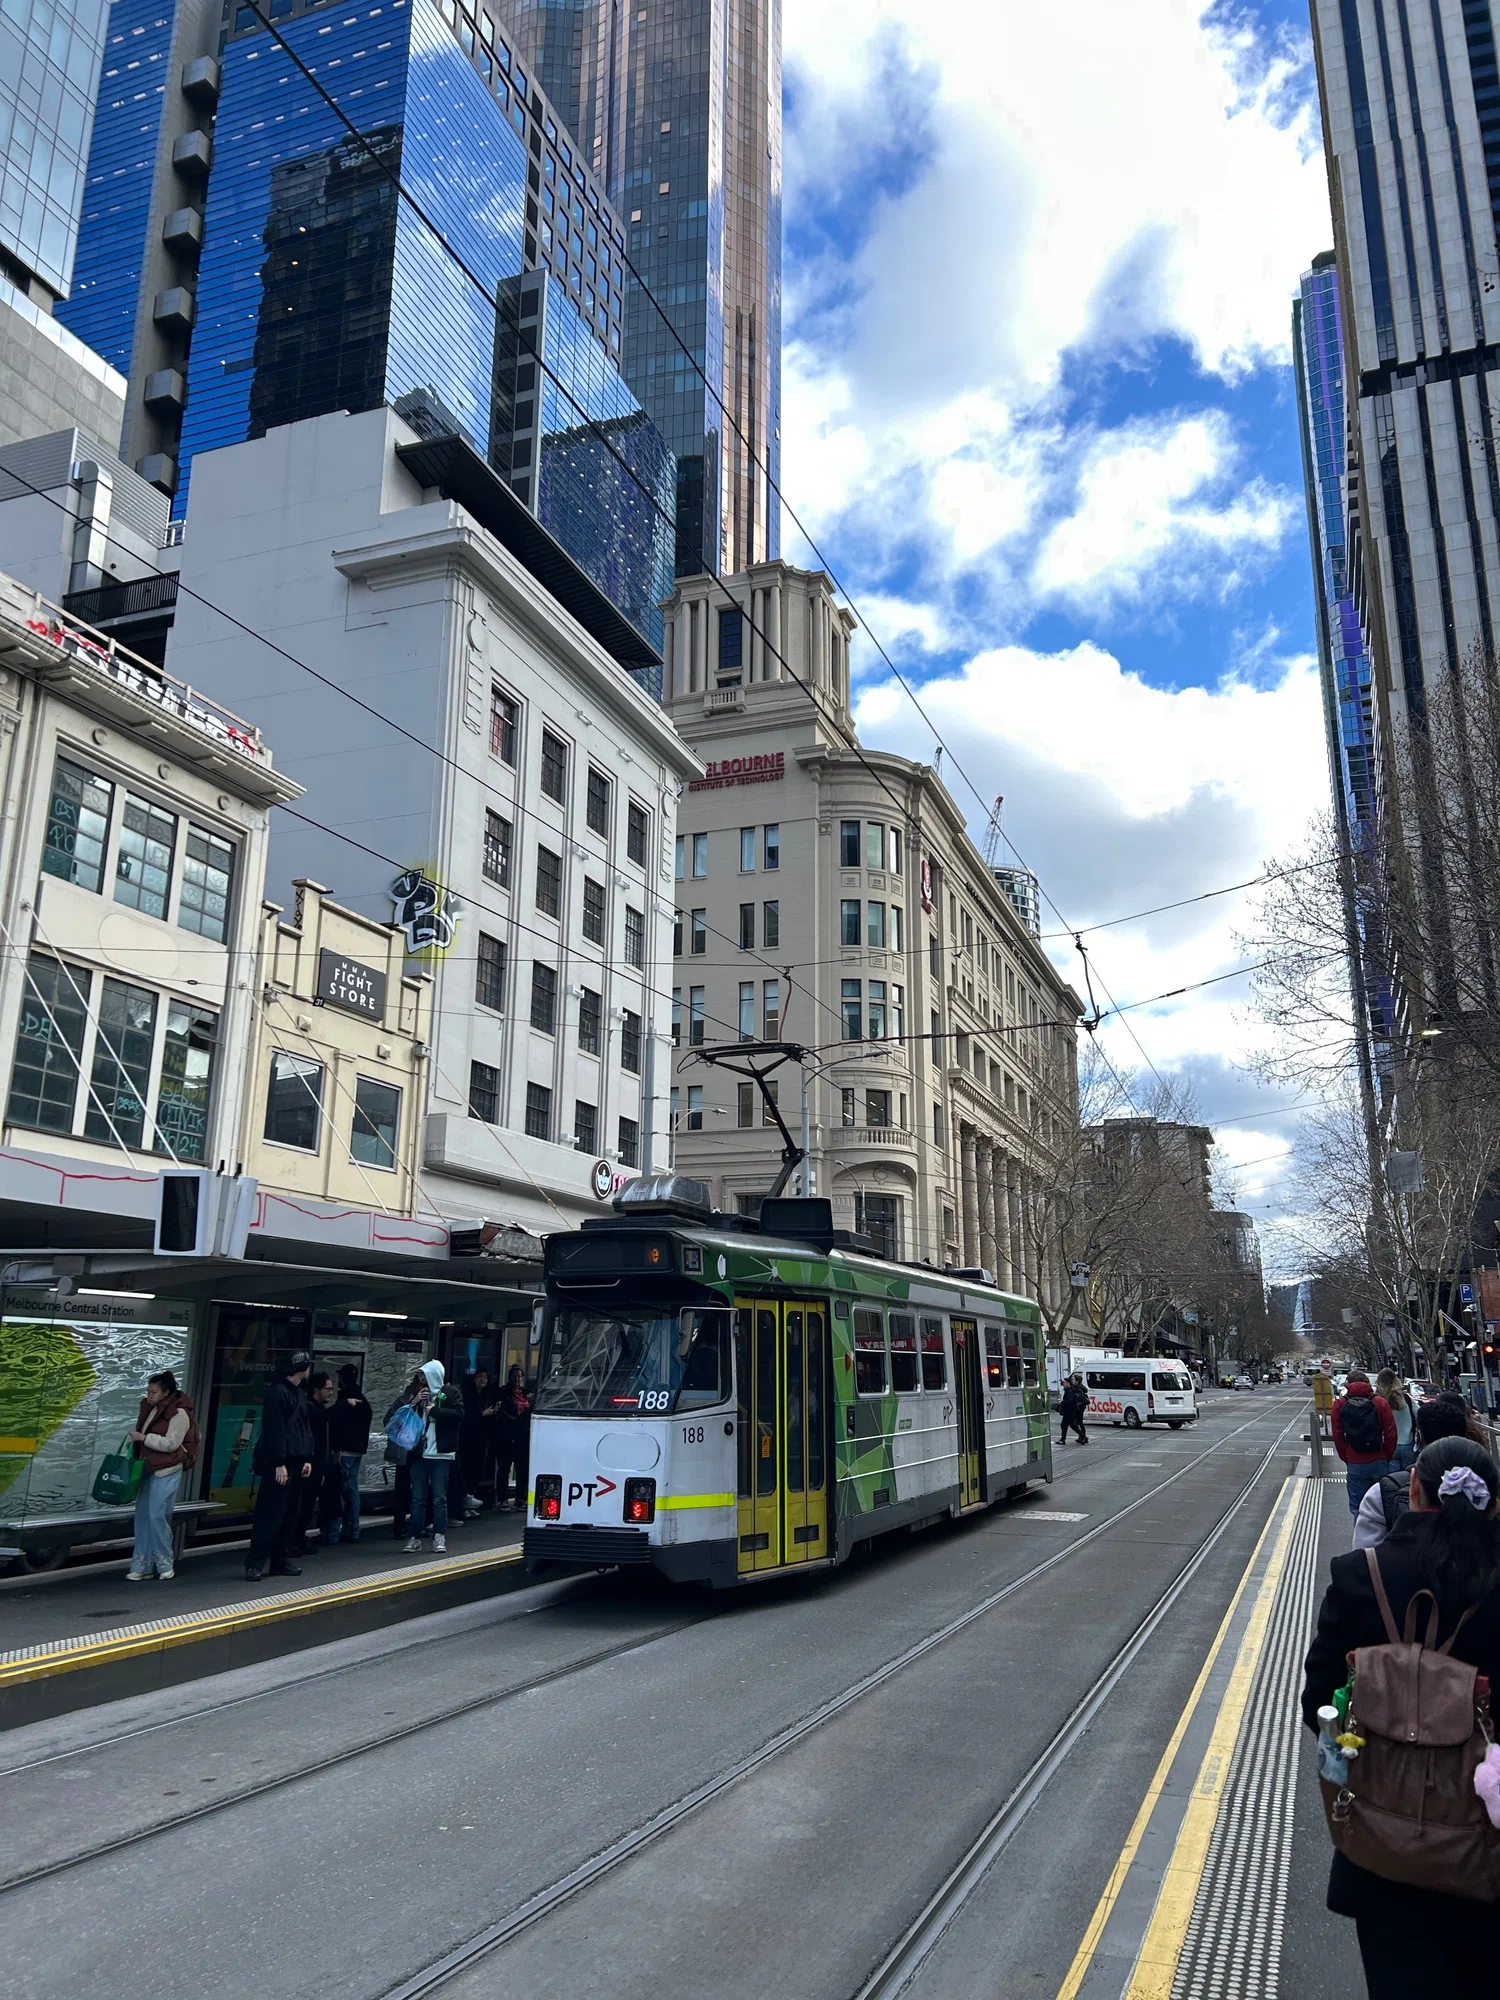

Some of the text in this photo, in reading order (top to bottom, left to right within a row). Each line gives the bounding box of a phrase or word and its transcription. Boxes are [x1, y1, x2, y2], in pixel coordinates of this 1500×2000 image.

[706, 752, 784, 777] ELBOURNE
[689, 772, 784, 792] INSTITUTE OF TECHNOLOGY
[342, 962, 367, 977] MMA
[334, 968, 373, 992] FIGHT
[329, 982, 375, 1010] STORE
[1462, 1285, 1470, 1294] P
[5, 1296, 134, 1317] Melbourne Central Station
[169, 1310, 190, 1320] Stop 5
[637, 1390, 669, 1410] 188
[682, 1427, 704, 1444] 188
